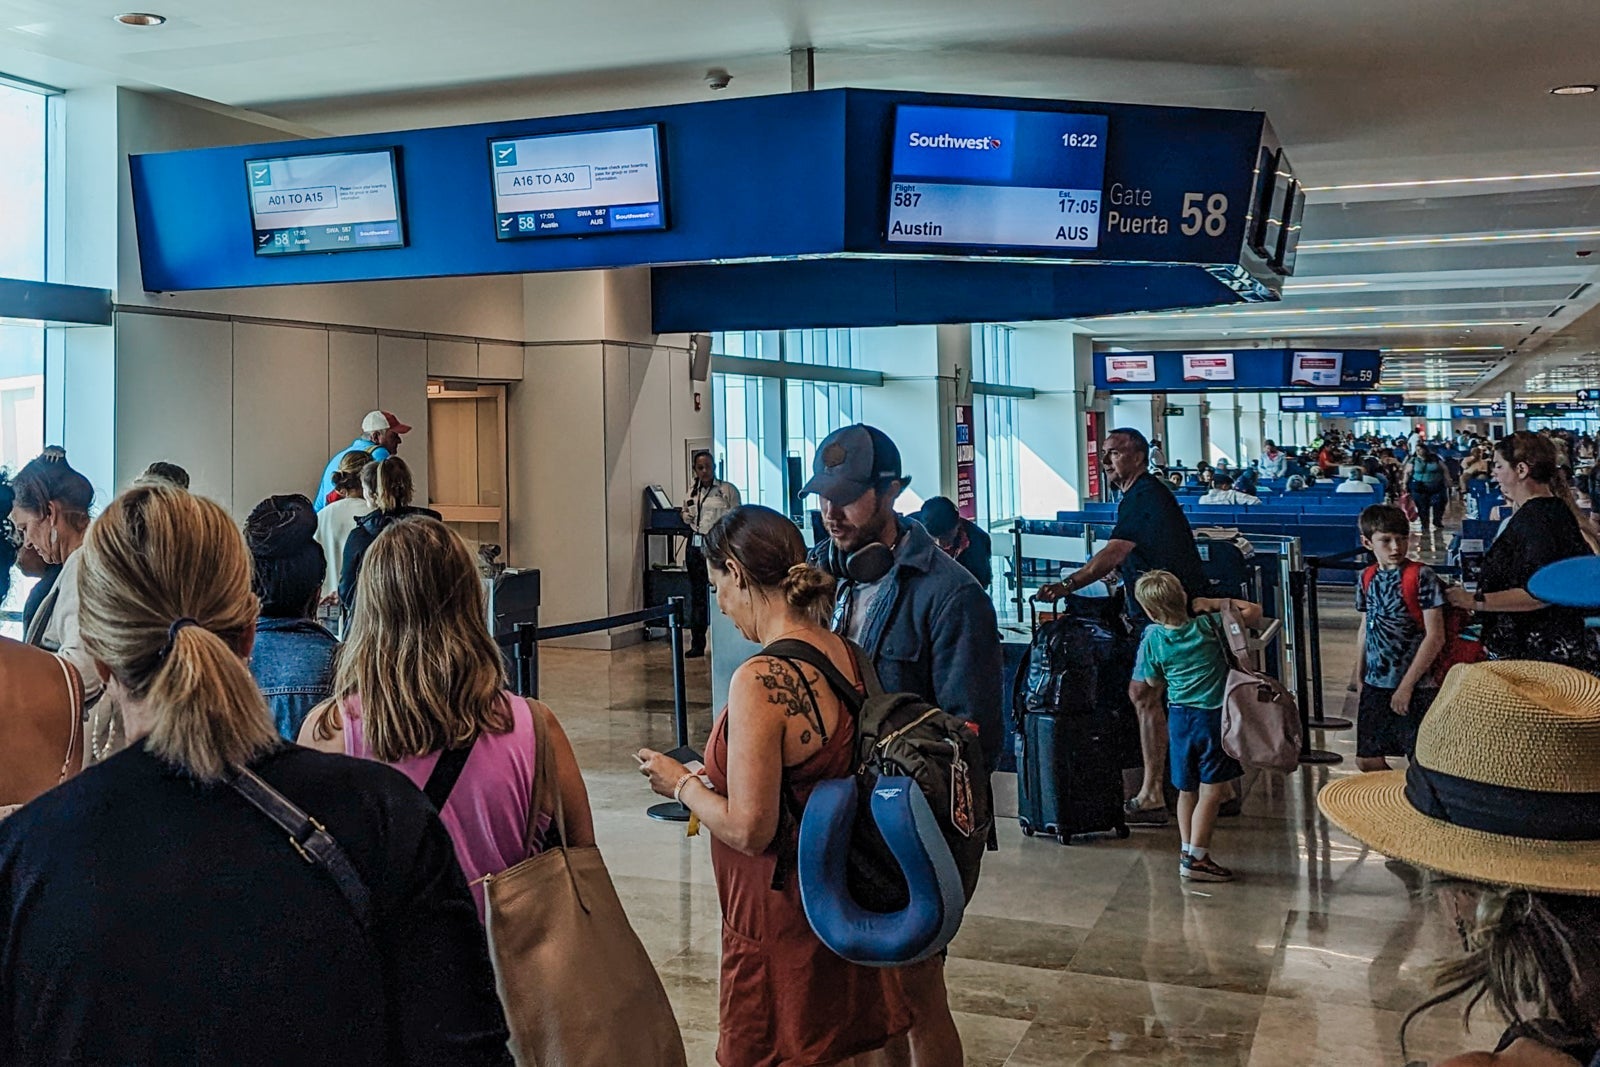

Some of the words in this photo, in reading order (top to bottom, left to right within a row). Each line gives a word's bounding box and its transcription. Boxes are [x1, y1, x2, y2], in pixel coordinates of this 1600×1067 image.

[909, 133, 990, 150] Southwest
[1062, 134, 1097, 148] 16:22
[513, 175, 533, 187] A16
[536, 174, 552, 185] TO
[554, 172, 575, 184] A30
[894, 184, 915, 193] Flight
[1110, 182, 1152, 206] Gate
[268, 194, 285, 206] A01
[288, 193, 303, 204] TO
[304, 192, 323, 202] A15
[894, 193, 922, 207] 587
[1059, 199, 1098, 214] 17:05
[1181, 192, 1228, 236] 58
[519, 217, 534, 230] 58
[892, 221, 942, 236] Austin
[1108, 211, 1168, 234] Puerta
[274, 234, 288, 245] 58
[1056, 226, 1088, 240] AUS
[1360, 370, 1373, 381] 59
